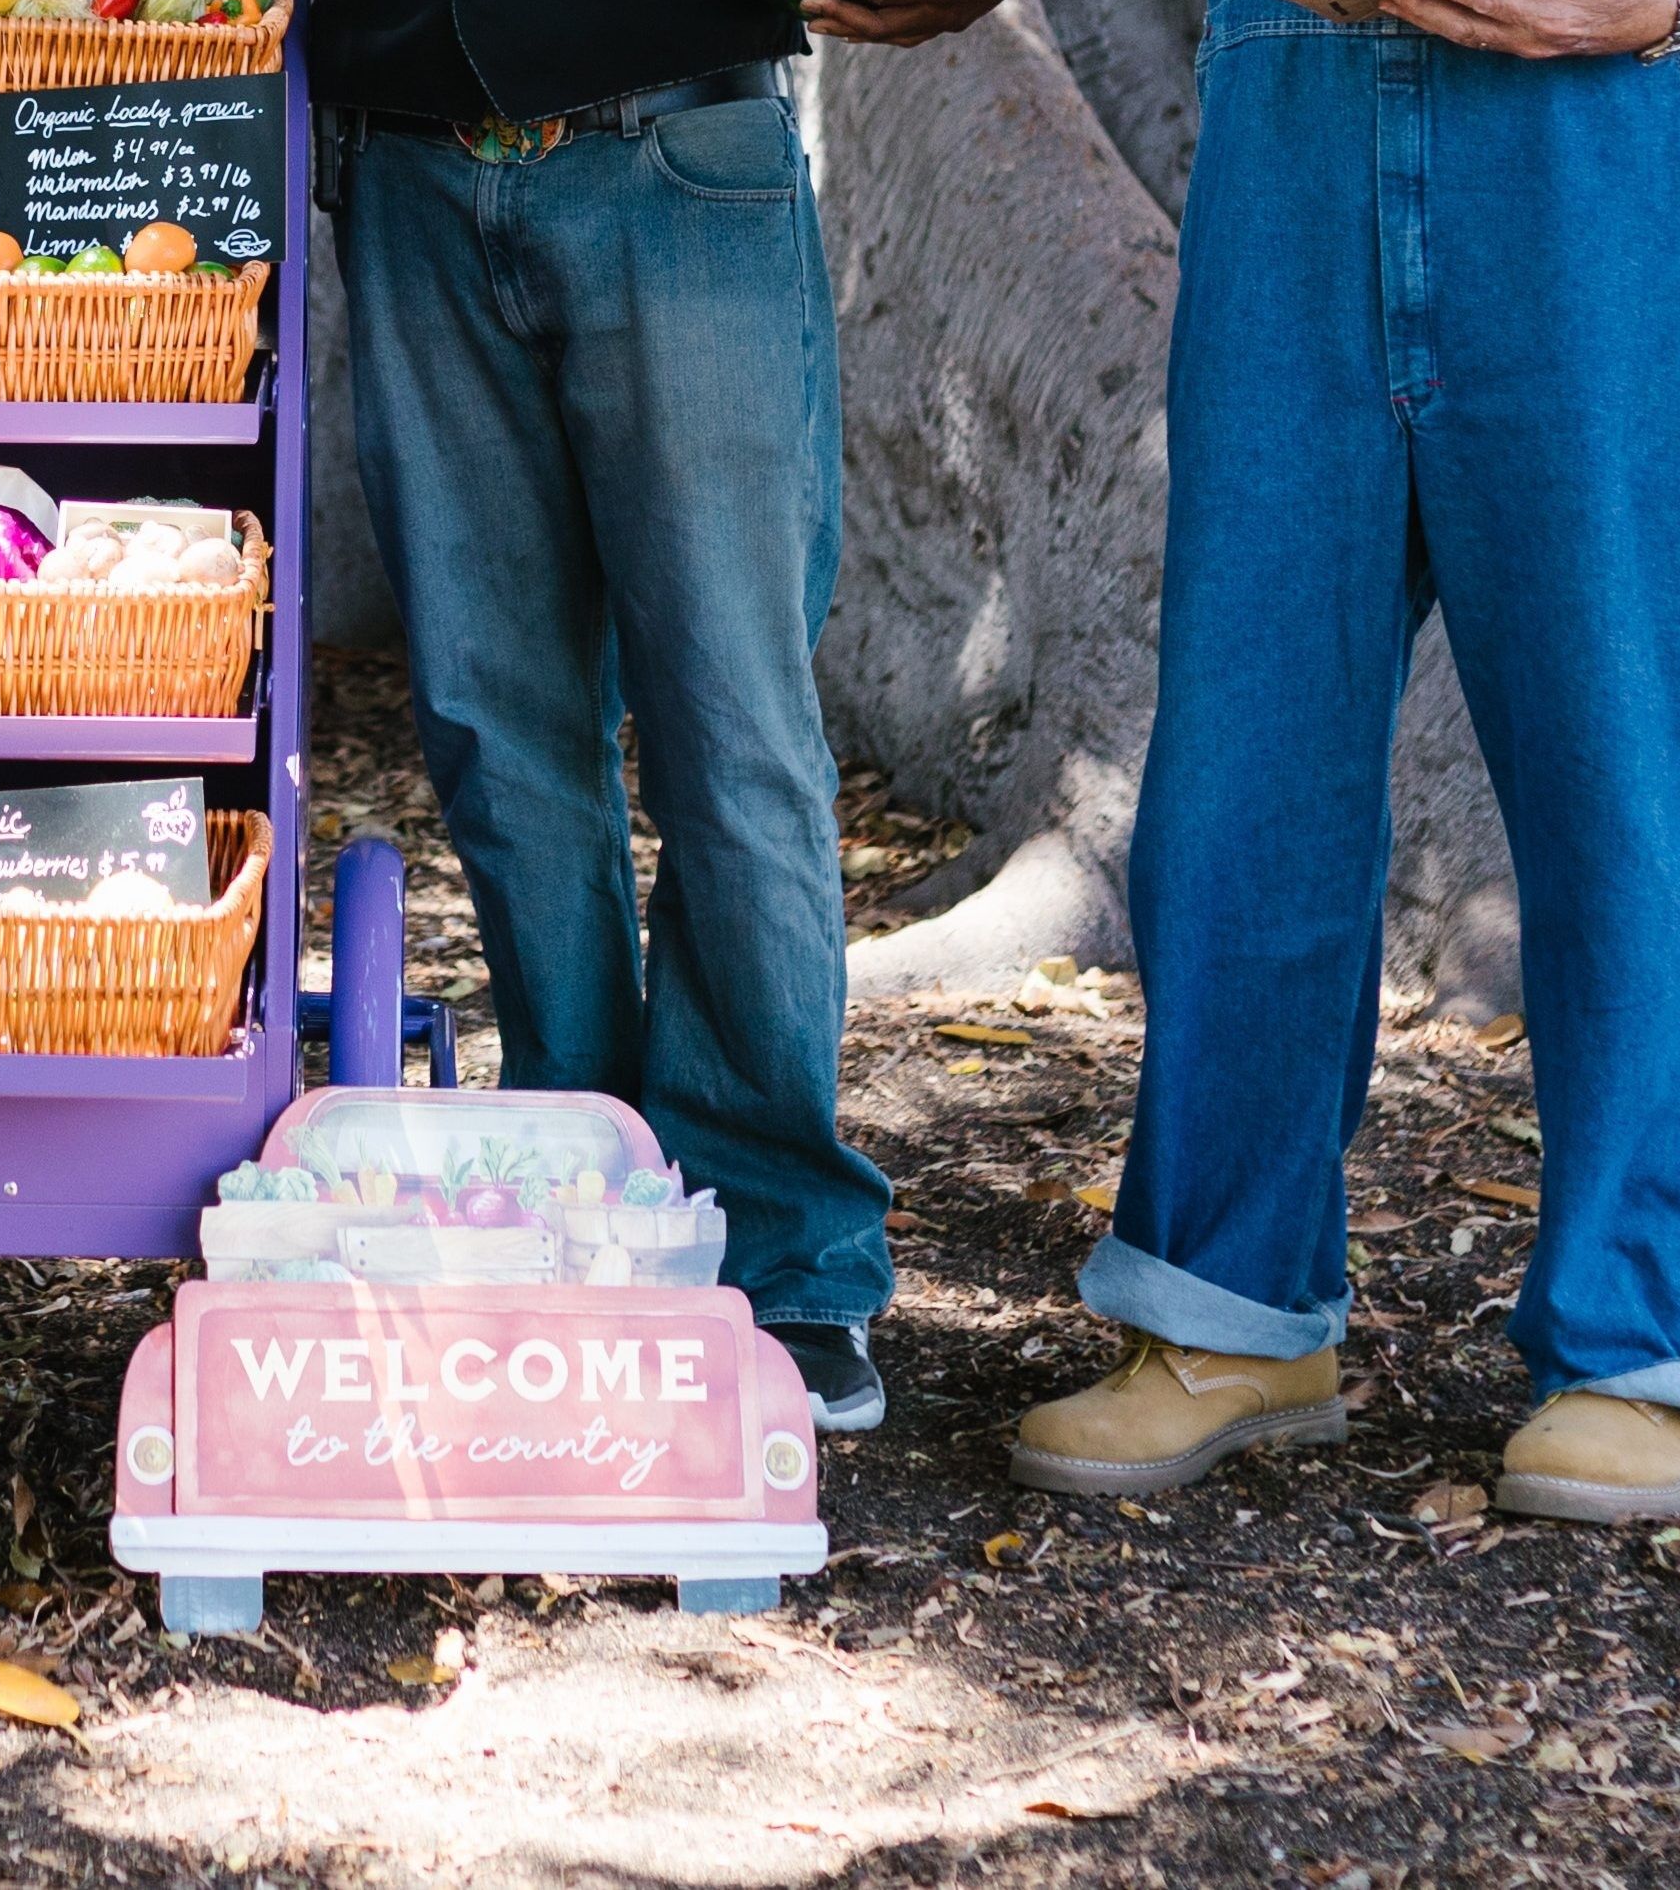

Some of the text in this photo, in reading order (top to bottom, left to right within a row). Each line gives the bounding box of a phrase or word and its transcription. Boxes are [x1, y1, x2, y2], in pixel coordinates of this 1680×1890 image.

[27, 146, 97, 170] Melon
[24, 196, 159, 222] Mandarines
[231, 1338, 707, 1403] WELCOME
[286, 1412, 670, 1491] to the country
